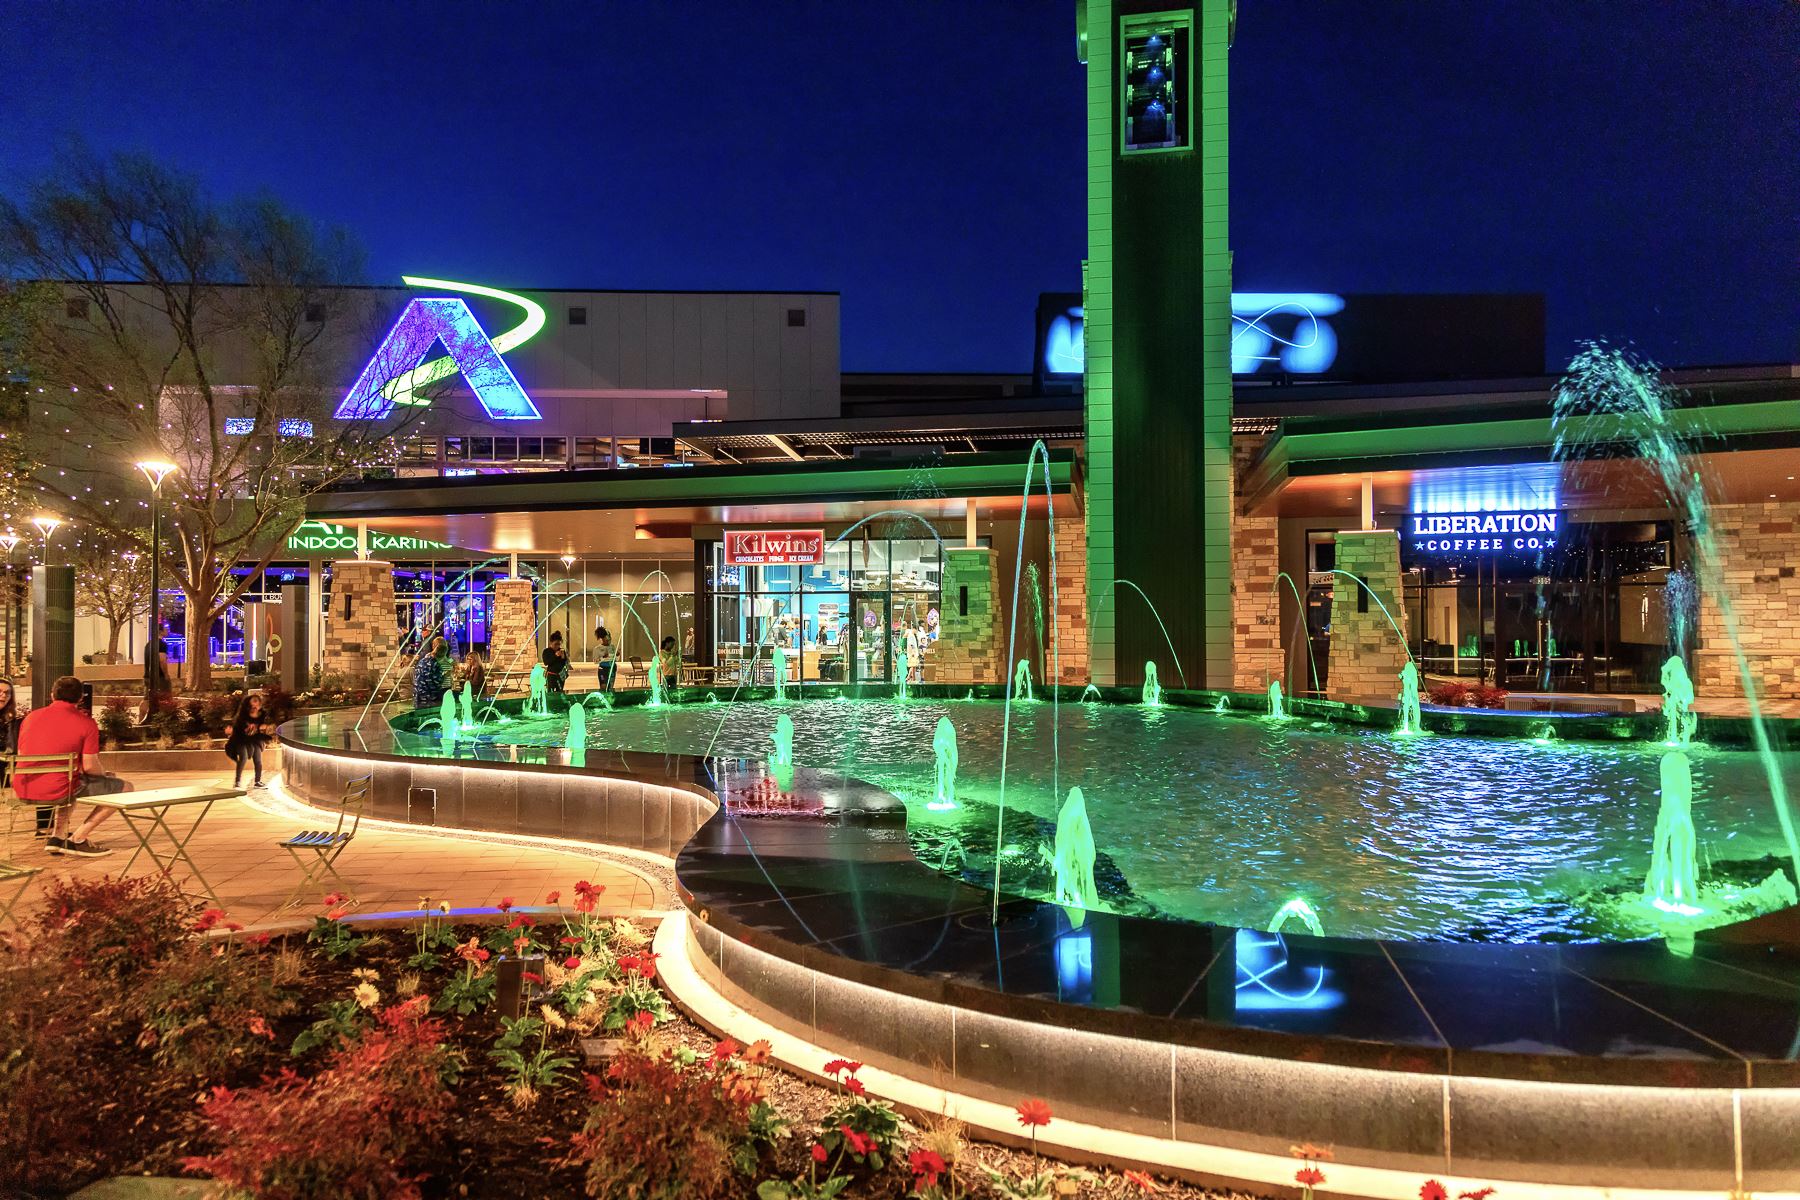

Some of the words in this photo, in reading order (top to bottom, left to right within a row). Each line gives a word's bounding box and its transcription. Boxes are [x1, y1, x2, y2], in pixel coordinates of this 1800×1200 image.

[1414, 513, 1557, 535] LIBERATION
[288, 536, 367, 549] INDOO
[732, 533, 817, 554] Kilwins
[1427, 539, 1503, 551] COFFEE
[1514, 538, 1544, 549] CO.
